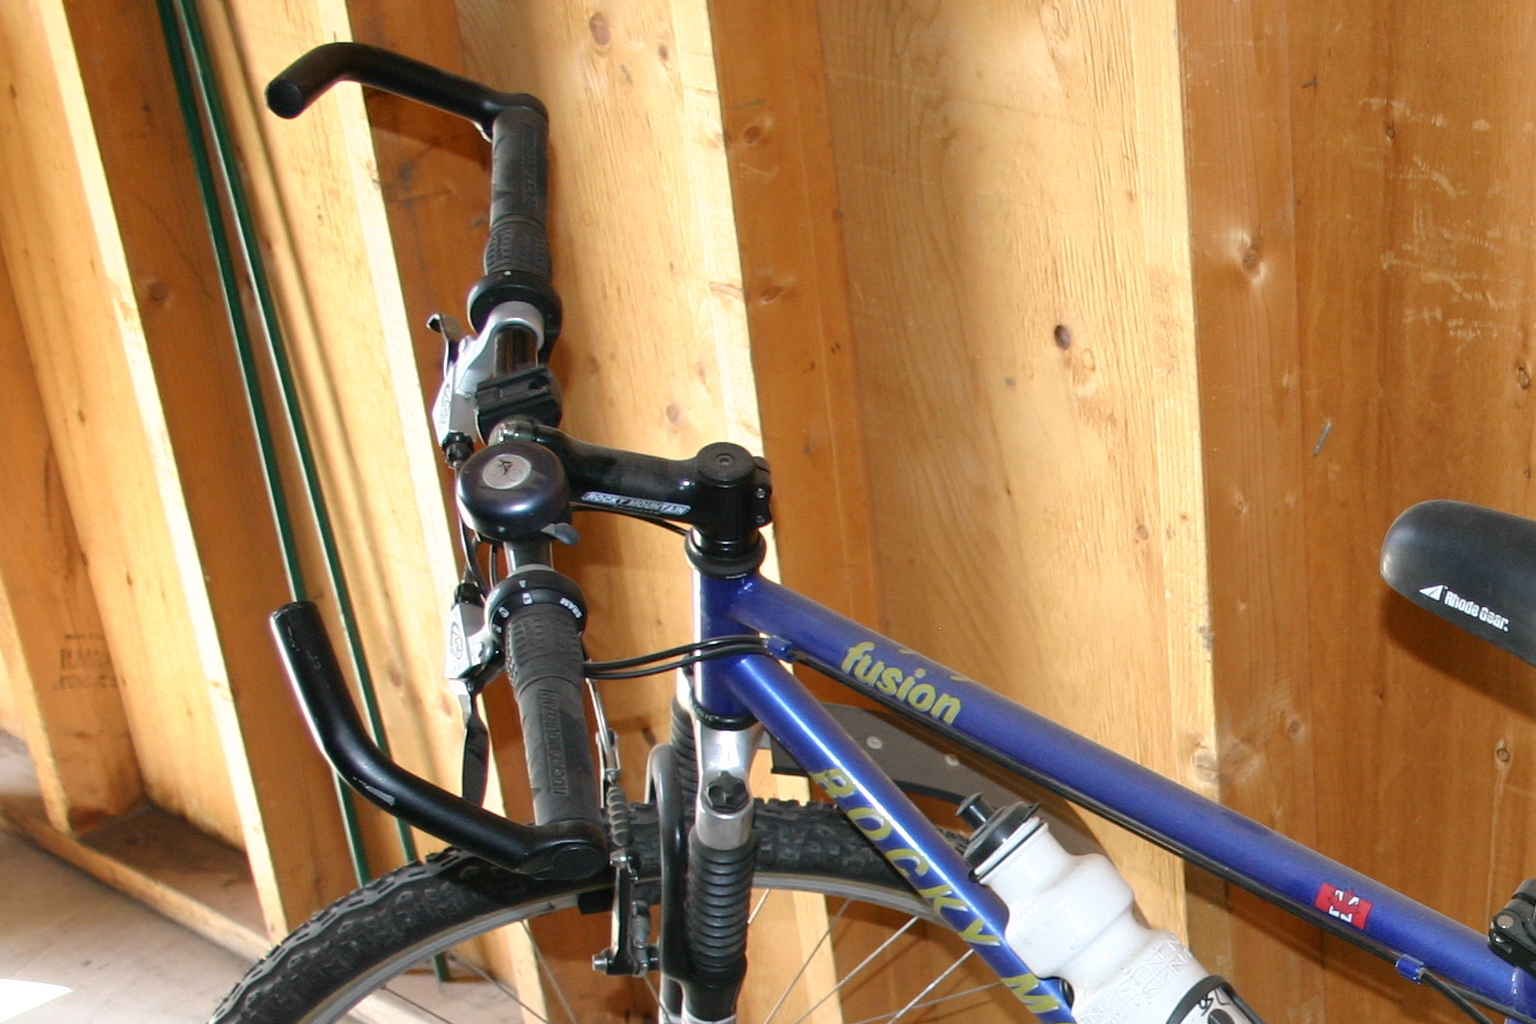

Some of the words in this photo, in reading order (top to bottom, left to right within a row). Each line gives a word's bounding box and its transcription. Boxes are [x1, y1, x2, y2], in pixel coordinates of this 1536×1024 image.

[586, 492, 626, 505] ROCKY
[626, 499, 688, 515] MOUNTAIN
[559, 597, 582, 618] SRAM
[840, 641, 961, 726] fusion
[809, 768, 1001, 947] ROCKY
